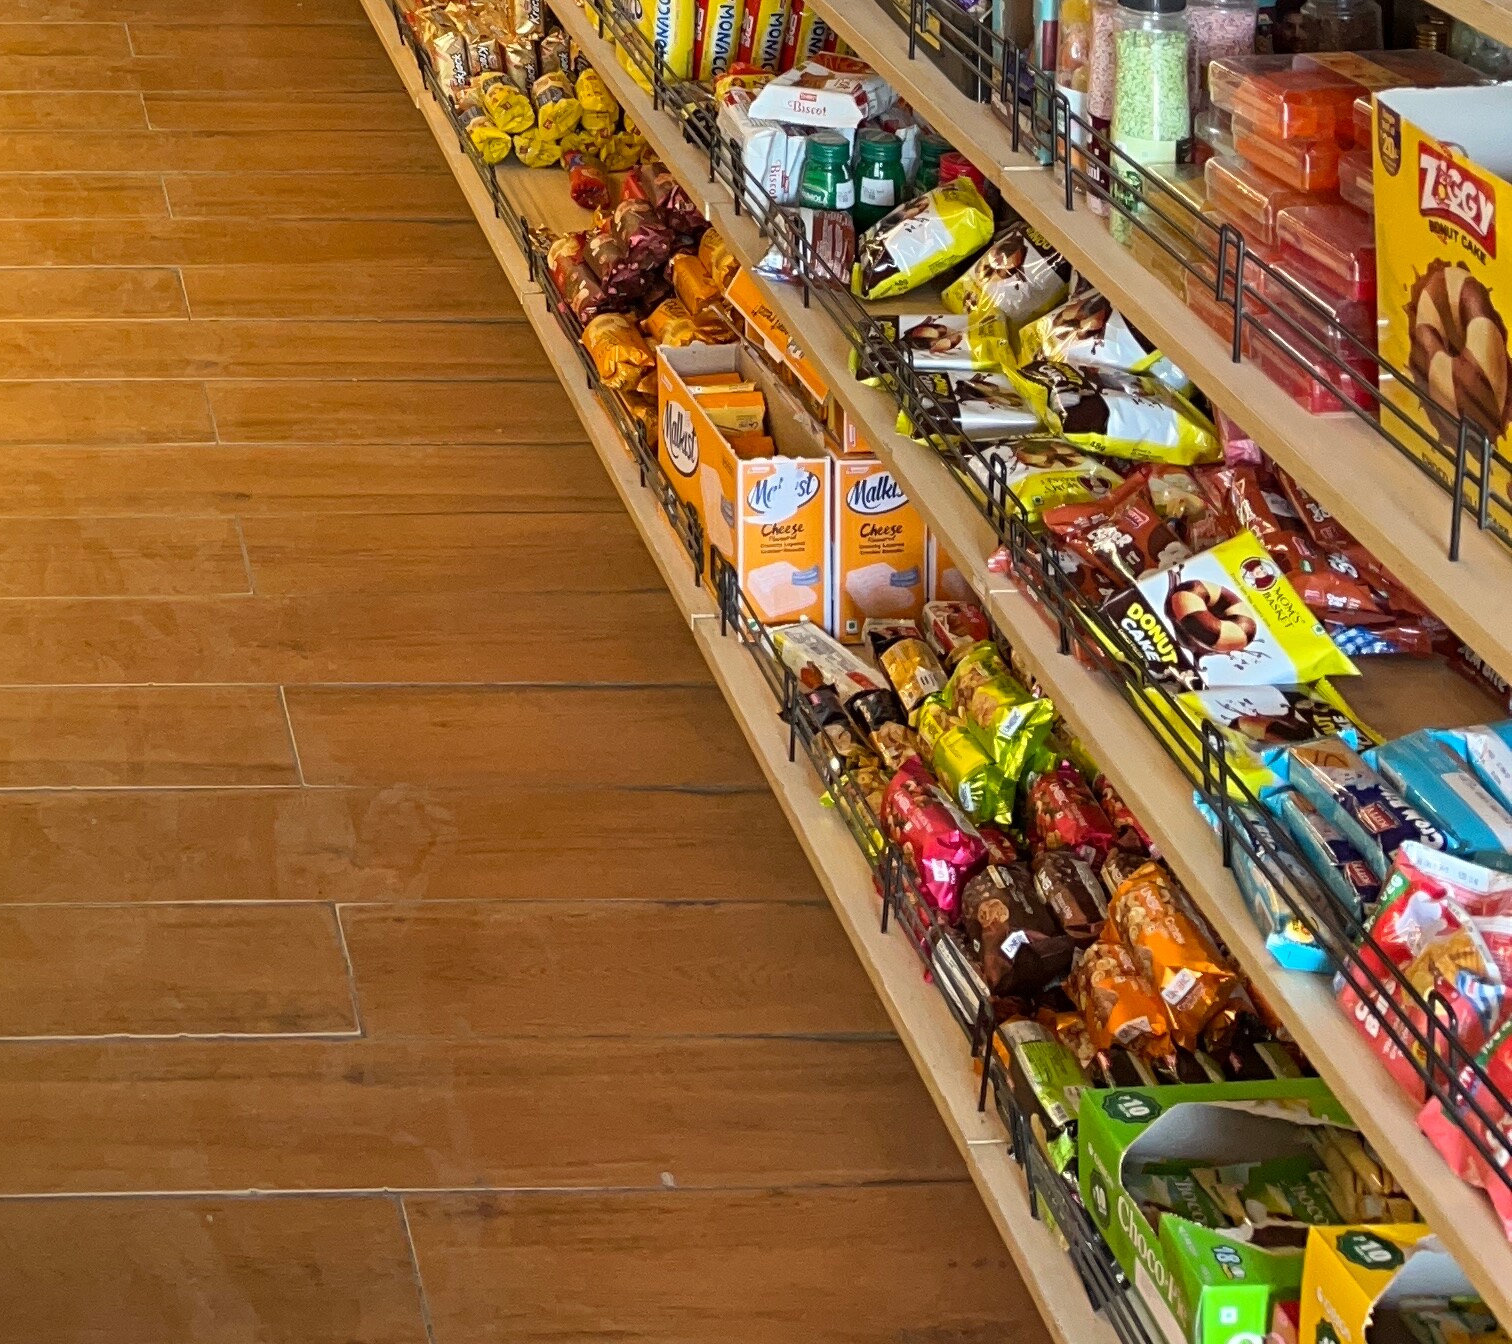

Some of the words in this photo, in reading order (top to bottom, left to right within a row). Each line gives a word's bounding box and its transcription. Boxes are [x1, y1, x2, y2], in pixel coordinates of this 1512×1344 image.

[1461, 234, 1489, 266] CAKE
[665, 400, 697, 463] Malkist
[761, 523, 804, 538] Cheese
[860, 523, 903, 538] Cheese
[1261, 590, 1295, 629] BASKET
[1273, 585, 1302, 625] MOM'S
[1119, 616, 1162, 663] CAKE
[1126, 601, 1179, 665] DONUT
